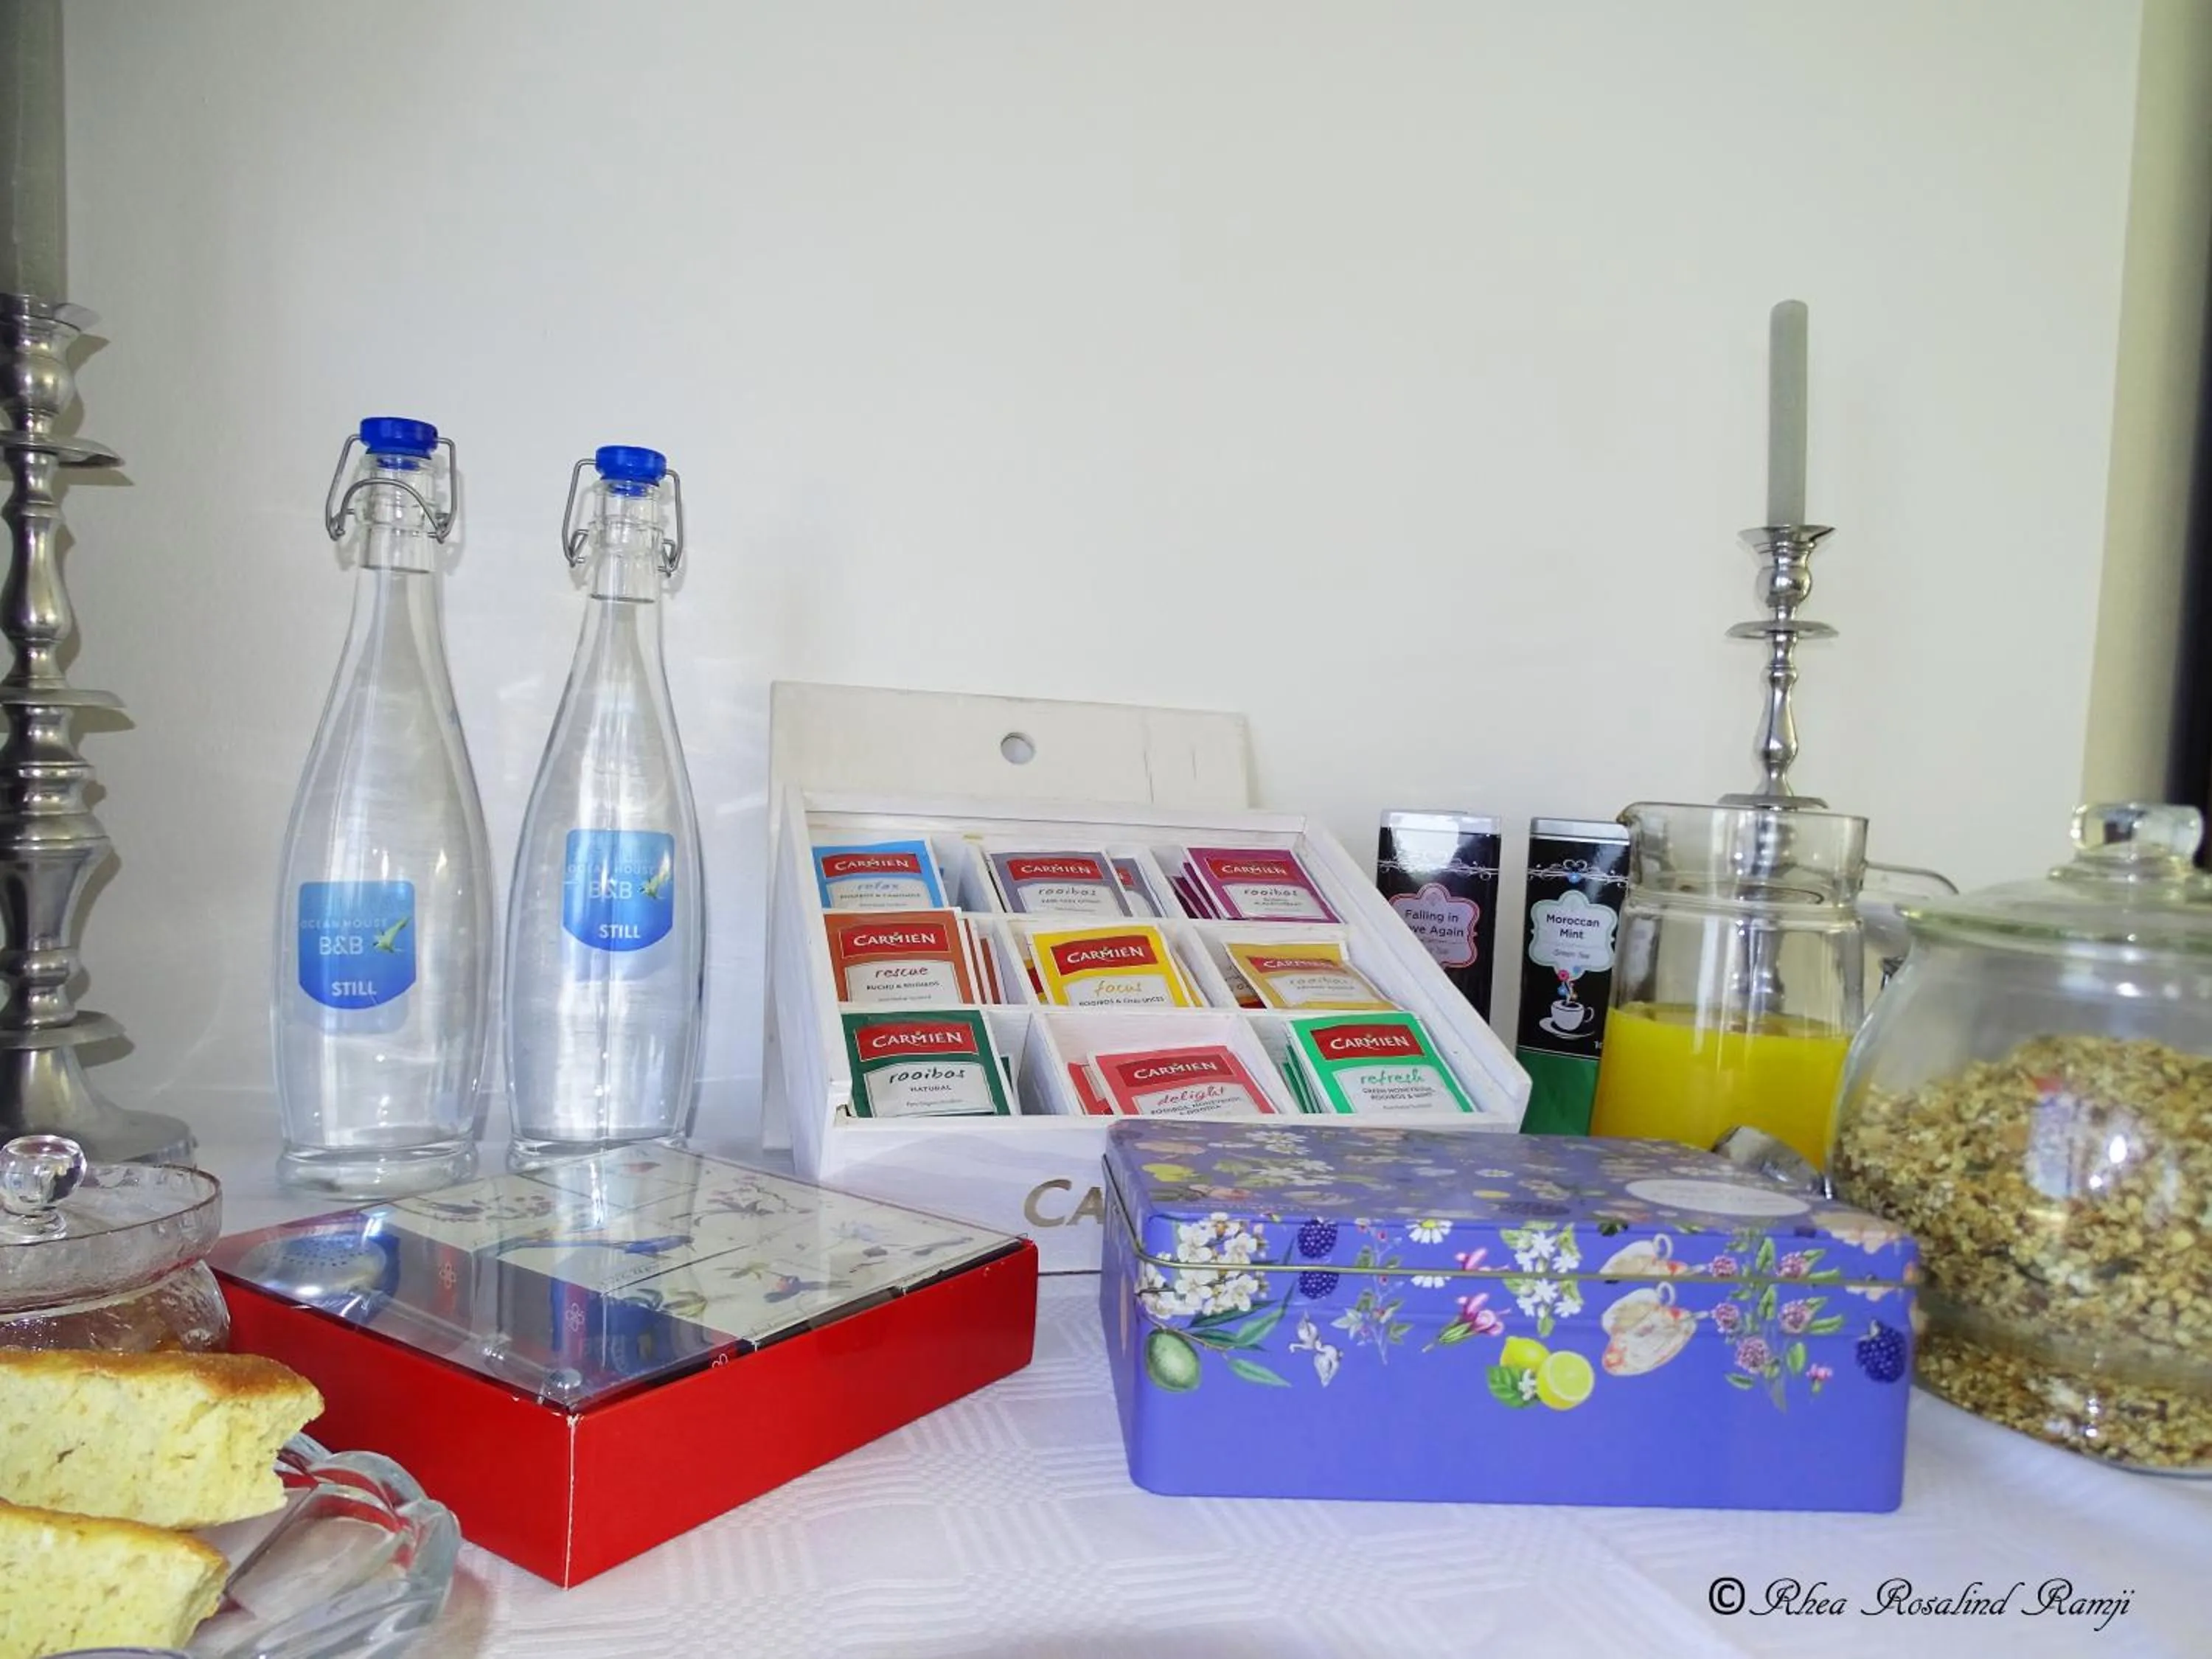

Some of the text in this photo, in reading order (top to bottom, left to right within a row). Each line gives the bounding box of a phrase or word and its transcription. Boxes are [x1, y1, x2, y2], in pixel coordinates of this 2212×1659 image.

[834, 858, 909, 871] CARMIEN
[1020, 863, 1092, 875] CARMIEN
[1221, 864, 1288, 876] CARMIEN
[589, 880, 633, 900] B&B
[1038, 886, 1097, 896] rooibos
[1243, 888, 1298, 897] rooibos
[342, 917, 388, 929] HOUSE
[1405, 908, 1459, 924] Falling in
[1545, 914, 1600, 928] Moroccan
[599, 923, 641, 939] STILL
[853, 931, 936, 947] CARMIEN
[1430, 925, 1464, 937] Again
[1559, 928, 1585, 939] Mint
[319, 935, 364, 956] B&B
[1066, 945, 1145, 964] CARMIEN
[874, 966, 929, 978] rescue
[331, 980, 378, 997] STILL
[1093, 980, 1143, 997] focus
[872, 1031, 963, 1048] CARMIEN
[1329, 1034, 1411, 1051] CARMIEN
[888, 1066, 965, 1085] rooibos
[1133, 1060, 1218, 1079] CARMIEN
[1360, 1068, 1425, 1085] refresh
[1157, 1085, 1224, 1106] delight
